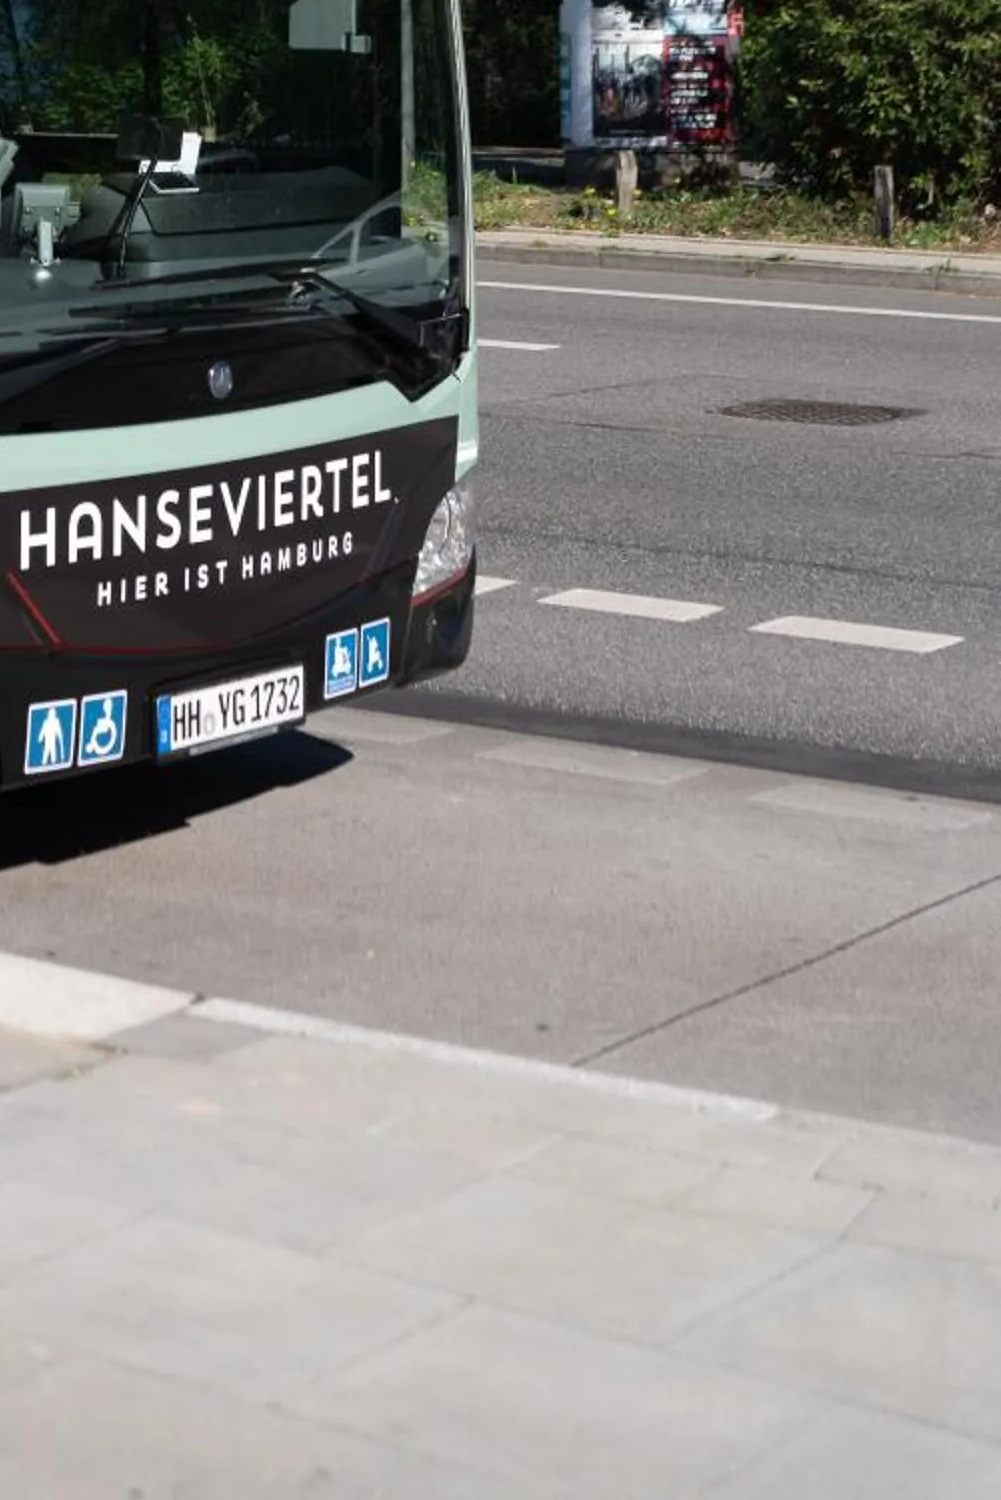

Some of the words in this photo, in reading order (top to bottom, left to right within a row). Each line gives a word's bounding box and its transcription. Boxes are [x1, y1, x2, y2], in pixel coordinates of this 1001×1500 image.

[19, 450, 392, 571] HANSEVIERTEL
[97, 575, 169, 606] HIER
[184, 560, 228, 592] IST
[241, 531, 354, 579] HAMBURG
[173, 699, 200, 742] HH
